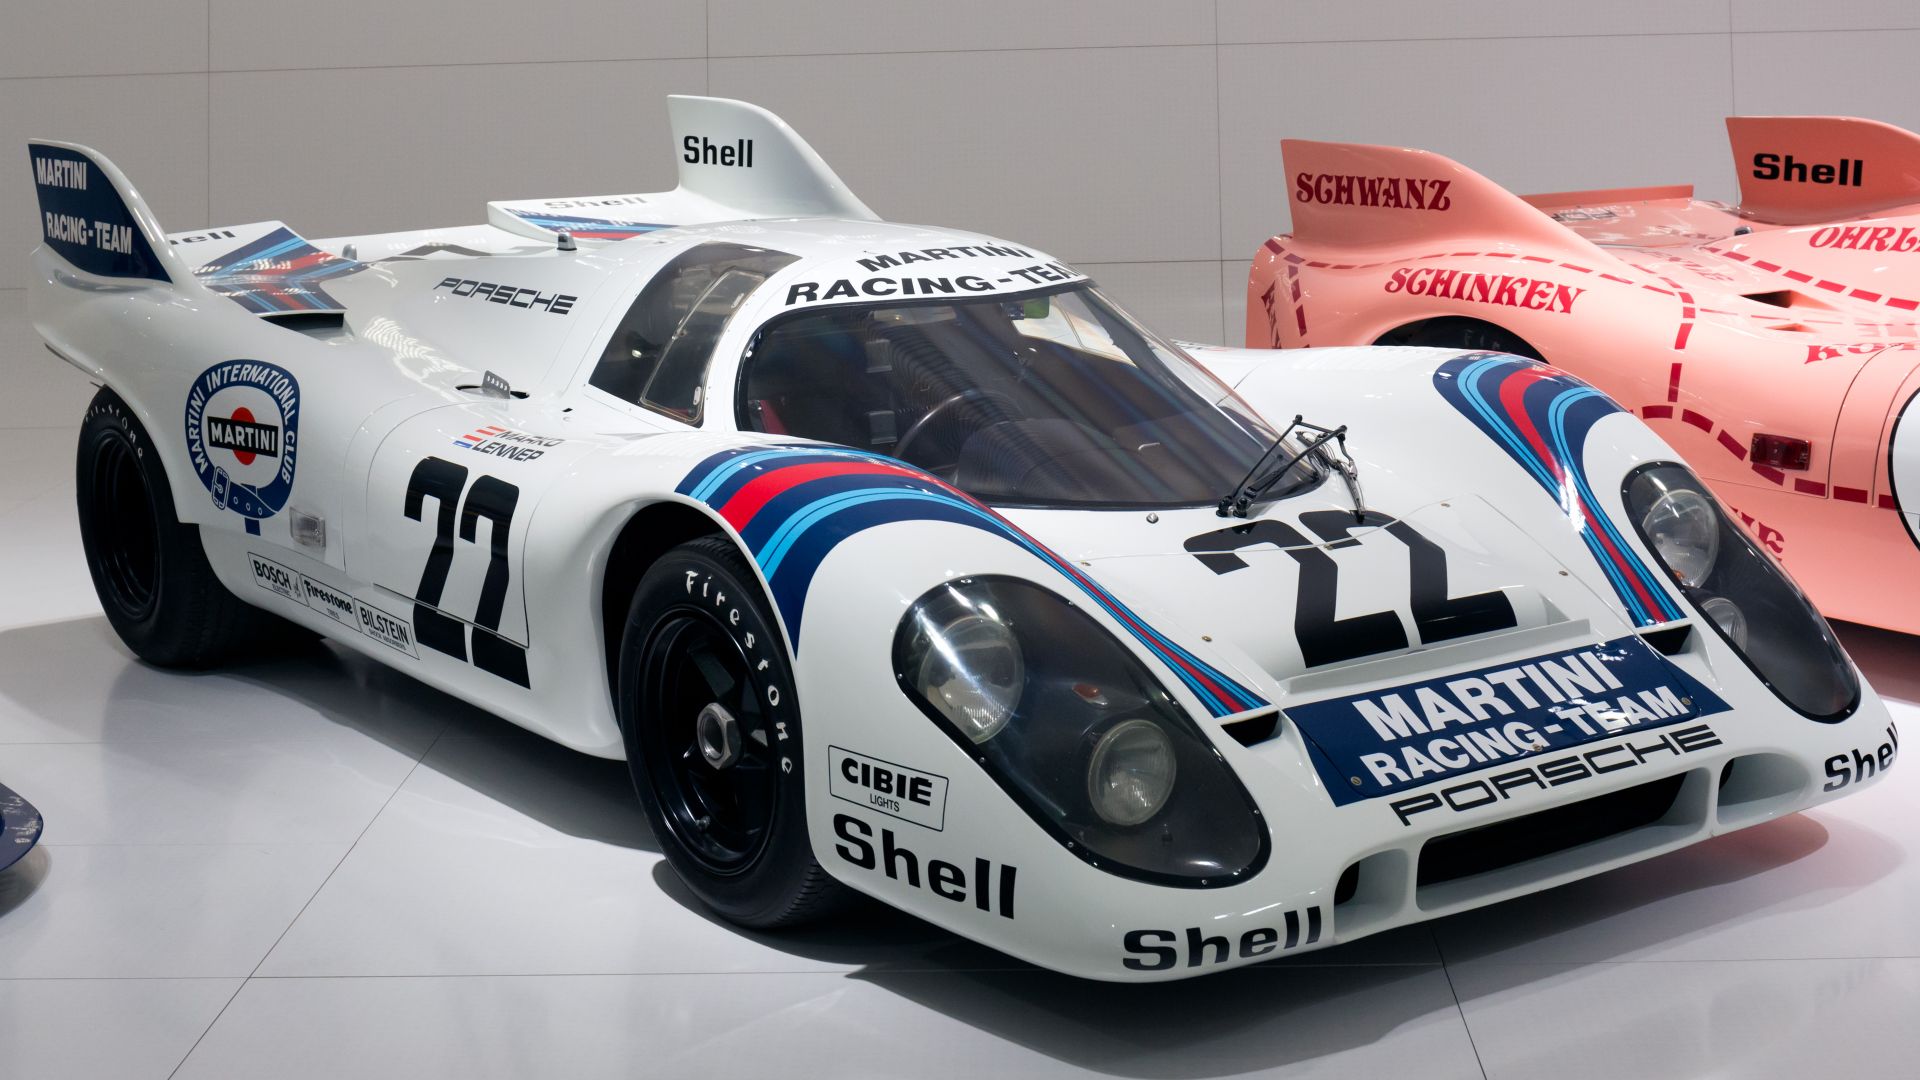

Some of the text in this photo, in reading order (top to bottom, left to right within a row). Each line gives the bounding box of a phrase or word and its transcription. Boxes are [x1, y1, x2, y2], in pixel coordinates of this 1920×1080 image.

[684, 136, 753, 167] Shell
[1753, 153, 1863, 187] Shell
[36, 156, 87, 190] MARTINI
[1296, 172, 1451, 212] SCHWANZ
[46, 211, 132, 254] RACING-TEAM
[1809, 226, 1920, 252] OHRL
[856, 245, 1035, 272] MARTINI
[433, 277, 578, 315] PORSCHE
[1384, 267, 1587, 314] SCHINKEN
[188, 364, 296, 485] MARTINI INTERNATIONAL CLUB
[210, 422, 275, 452] MARTINI
[472, 439, 545, 462] LENNEP
[253, 559, 292, 591] BOSCH
[404, 456, 531, 690] 22
[1183, 509, 1517, 669] 22
[304, 579, 354, 615] Firestone
[360, 605, 410, 646] BILSTEIN
[1351, 651, 1625, 742] MARTINI
[1389, 724, 1723, 827] PORSCHE
[870, 793, 900, 812] LIGHTS
[833, 813, 1017, 920] Shell
[1122, 905, 1322, 971] Shell
